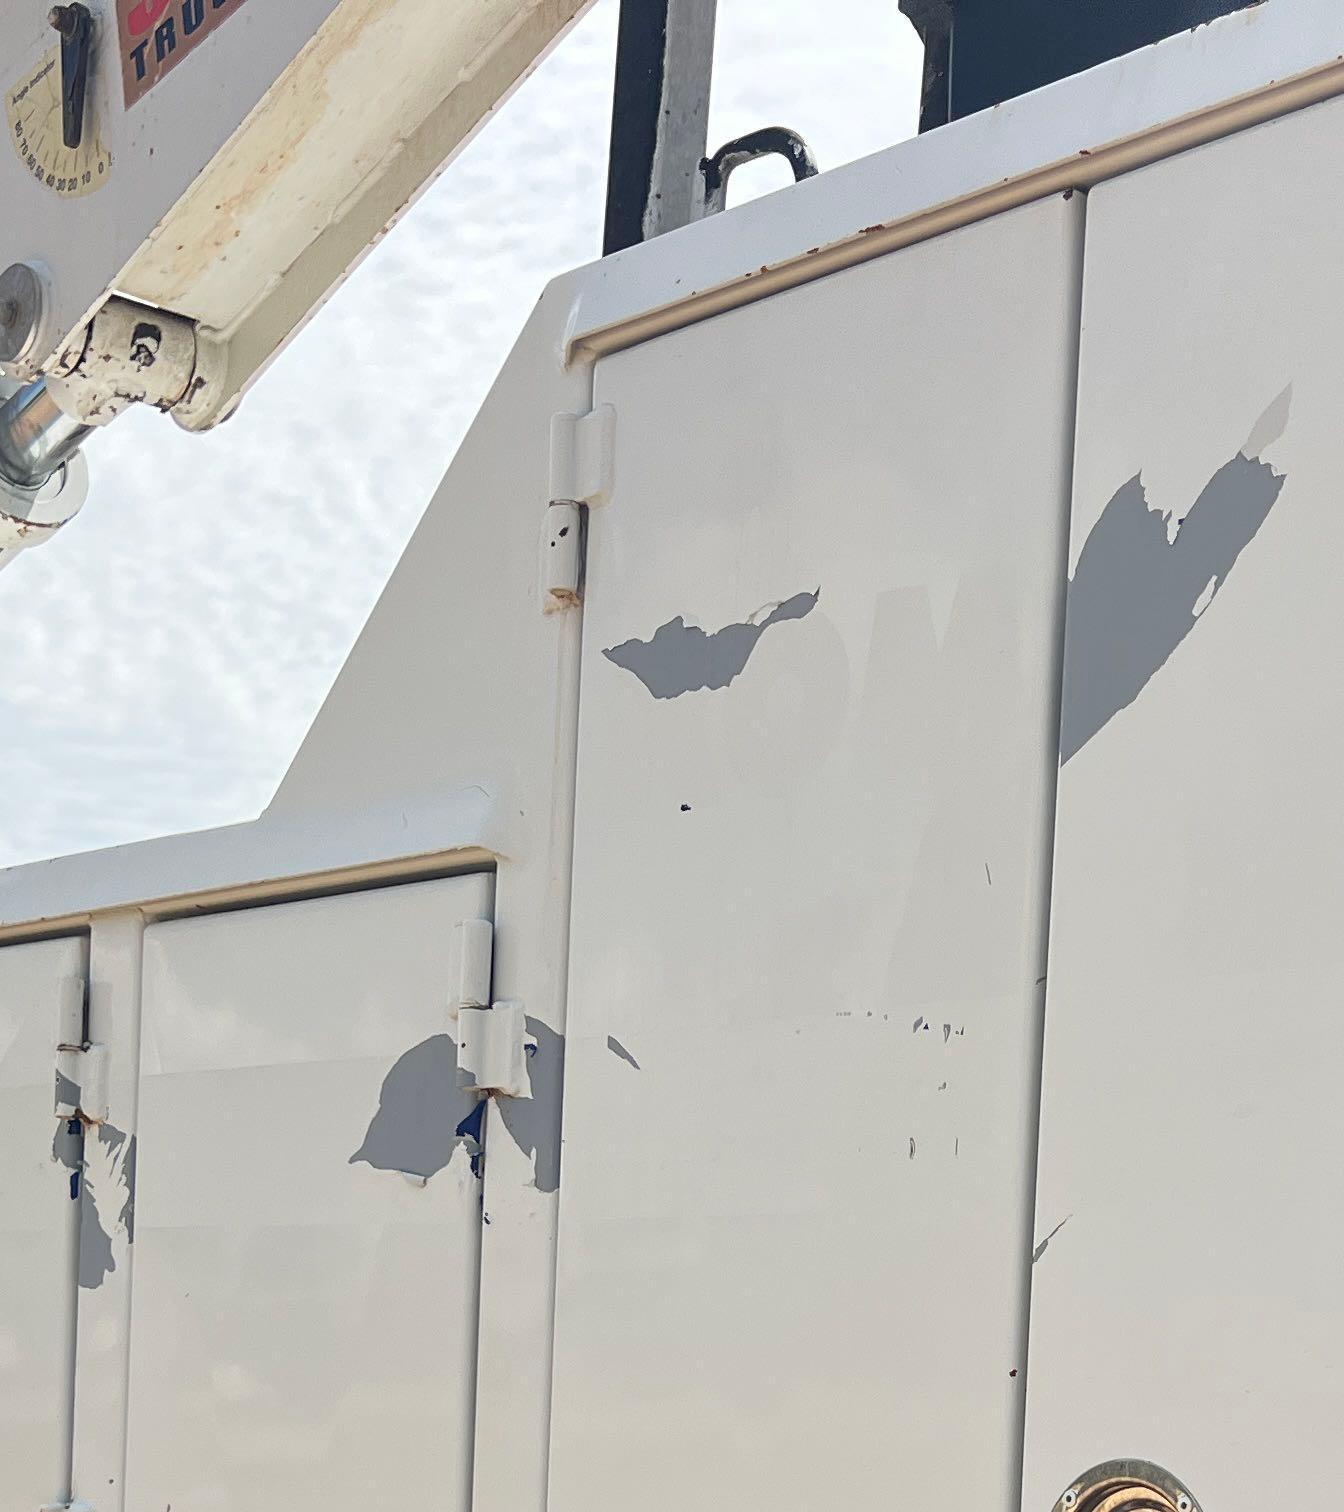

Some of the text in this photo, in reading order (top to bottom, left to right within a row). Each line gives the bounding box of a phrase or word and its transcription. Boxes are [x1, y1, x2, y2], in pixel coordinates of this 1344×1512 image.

[130, 0, 226, 81] TRU
[19, 138, 29, 156] 70
[46, 174, 56, 187] 40
[56, 178, 66, 191] 30
[67, 177, 78, 192] 20
[81, 170, 91, 186] 10
